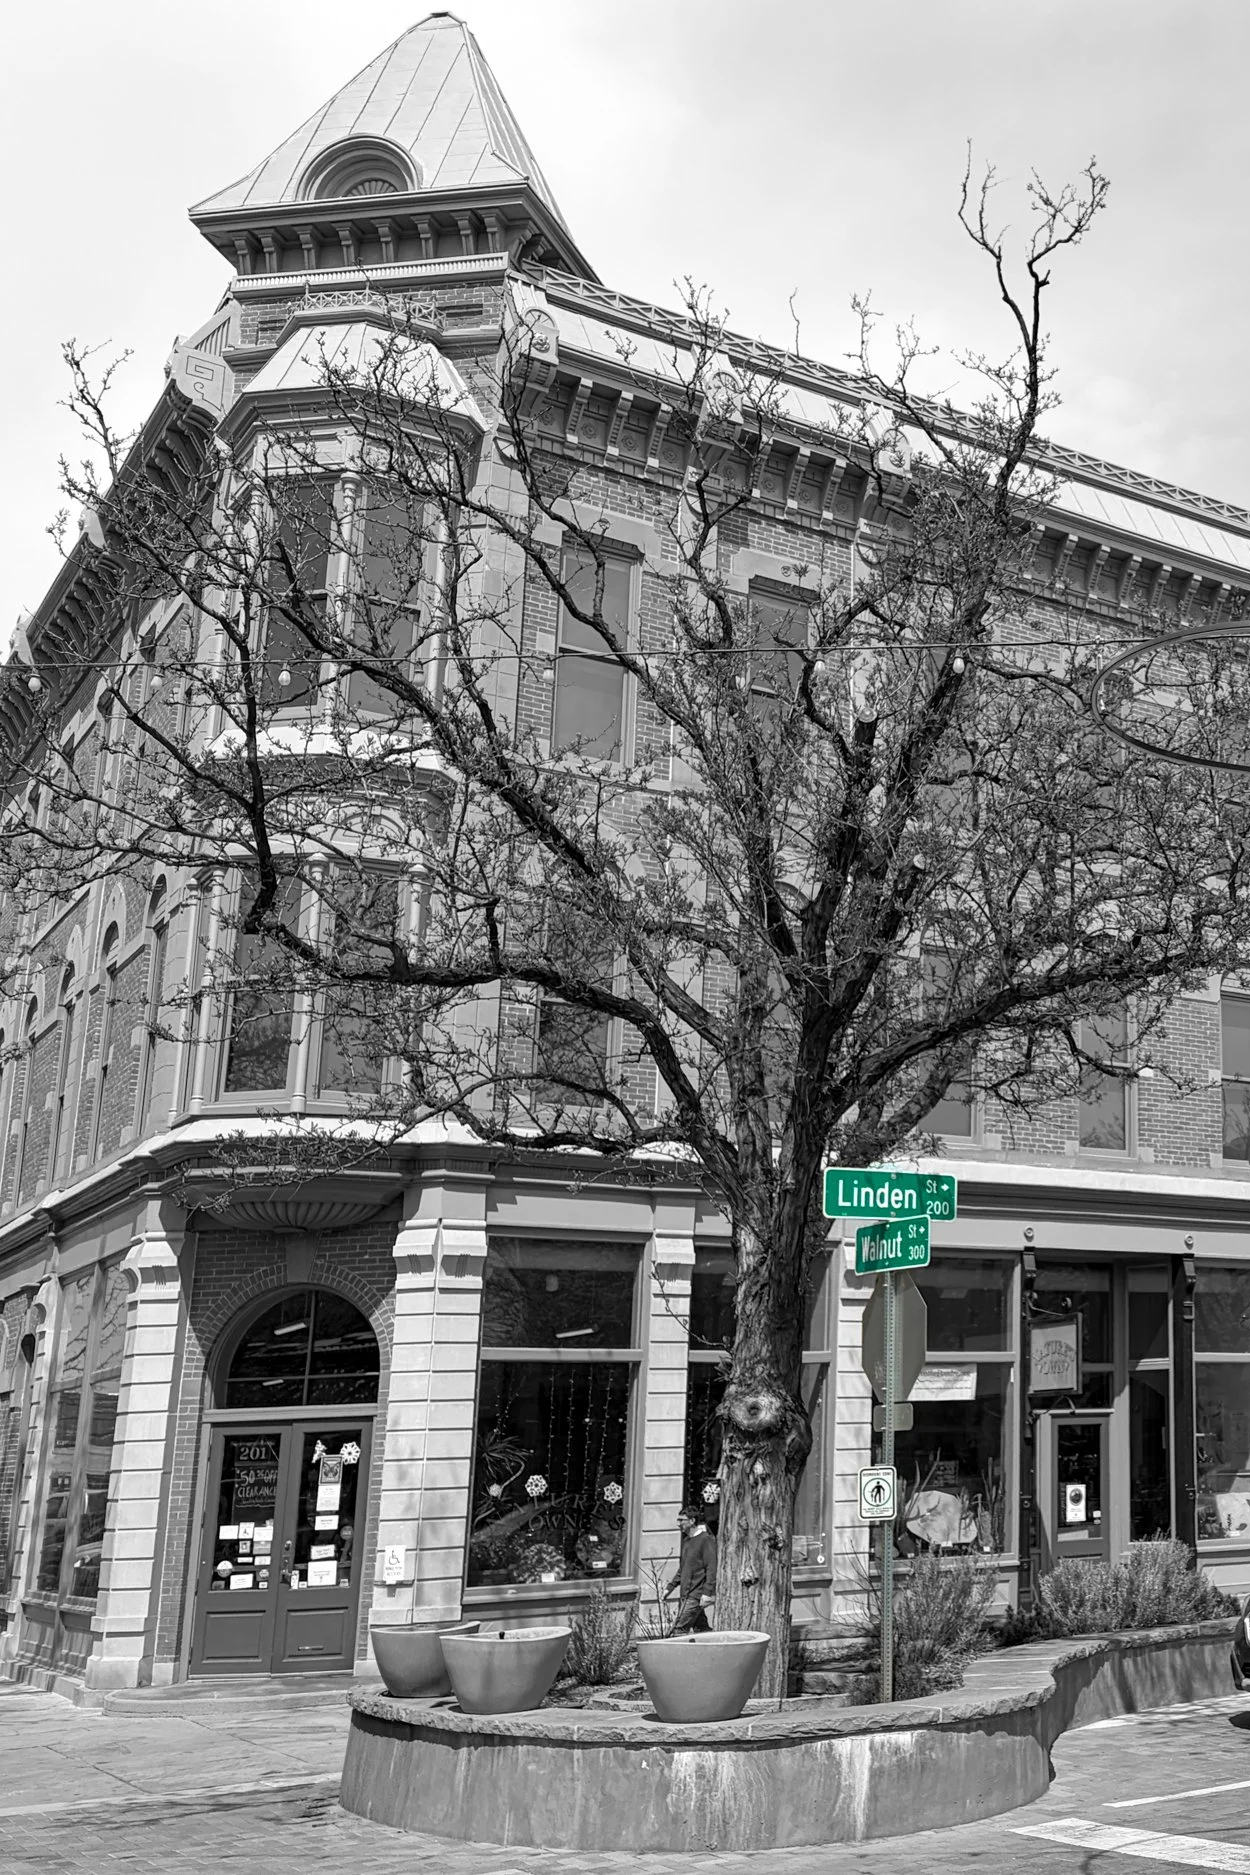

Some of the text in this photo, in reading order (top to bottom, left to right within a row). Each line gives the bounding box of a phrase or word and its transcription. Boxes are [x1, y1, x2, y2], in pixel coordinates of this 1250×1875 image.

[838, 1180, 938, 1209] Linden St
[926, 1201, 950, 1216] 200
[862, 1224, 918, 1263] Walnut St
[908, 1245, 926, 1261] 300
[240, 1447, 266, 1460] 201
[529, 1514, 578, 1530] OWN
